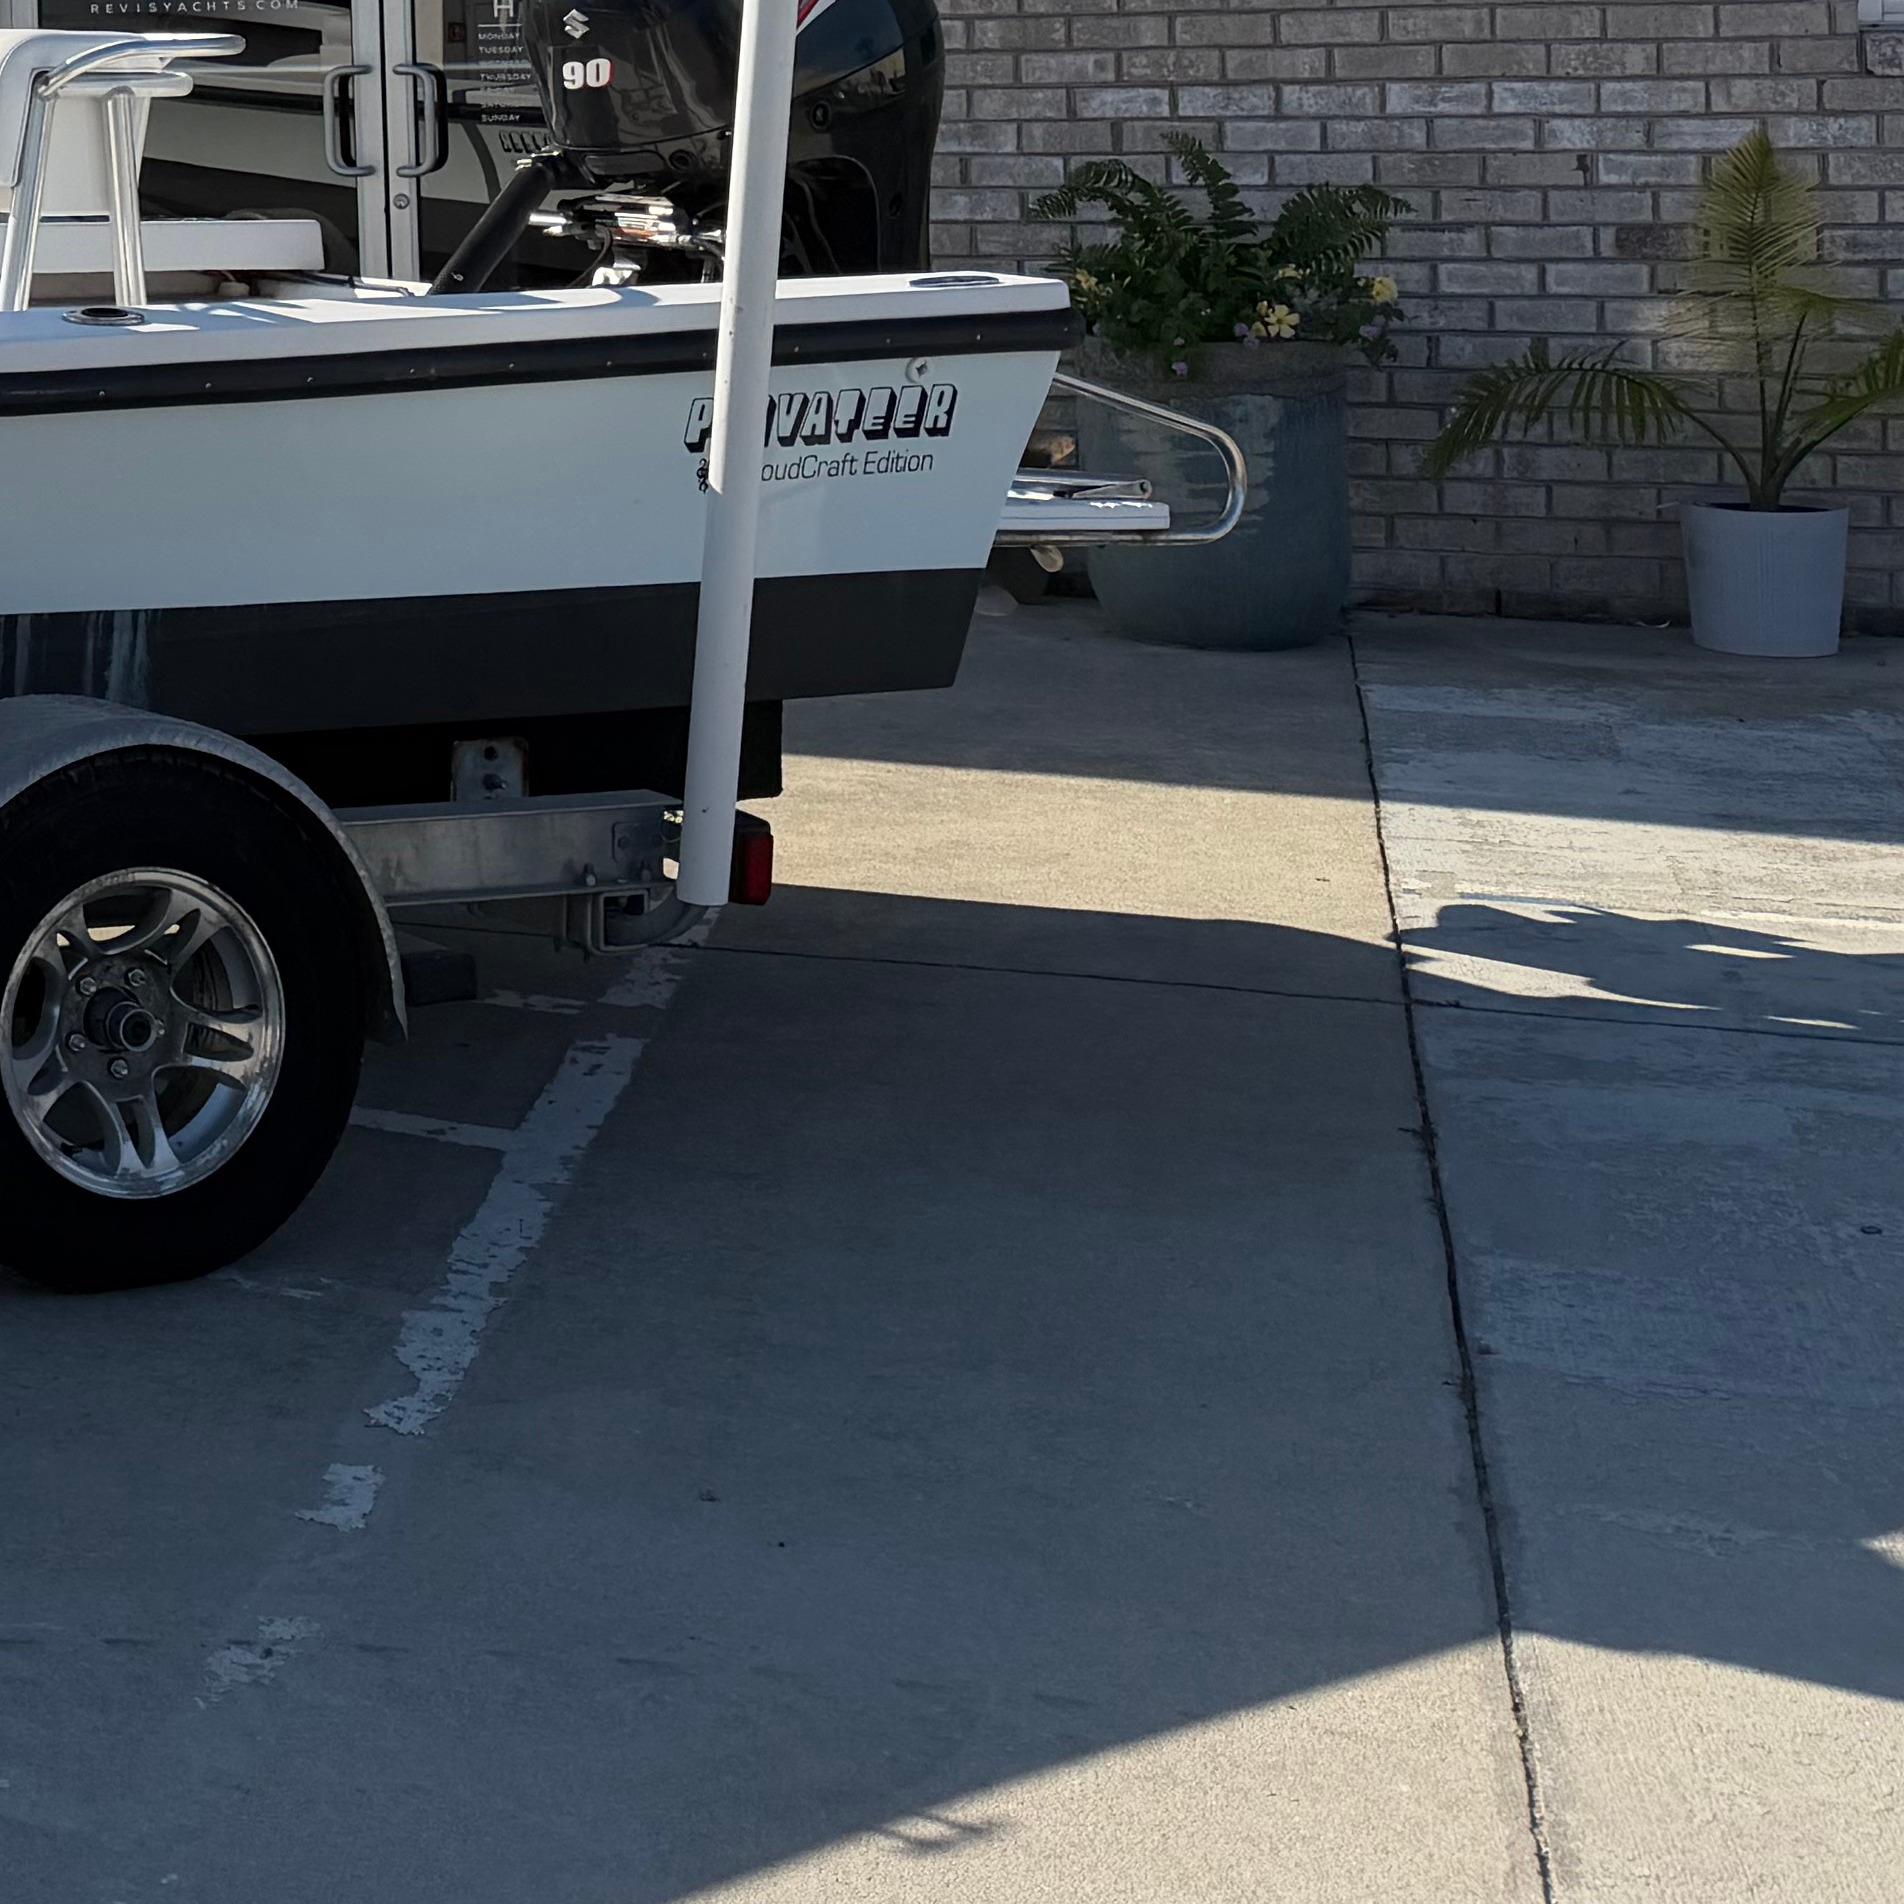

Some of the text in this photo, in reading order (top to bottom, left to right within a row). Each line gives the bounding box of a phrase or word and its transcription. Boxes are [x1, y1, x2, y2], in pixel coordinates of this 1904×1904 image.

[562, 58, 614, 90] 90
[684, 384, 958, 453] PVATEER
[863, 448, 934, 475] Edition
